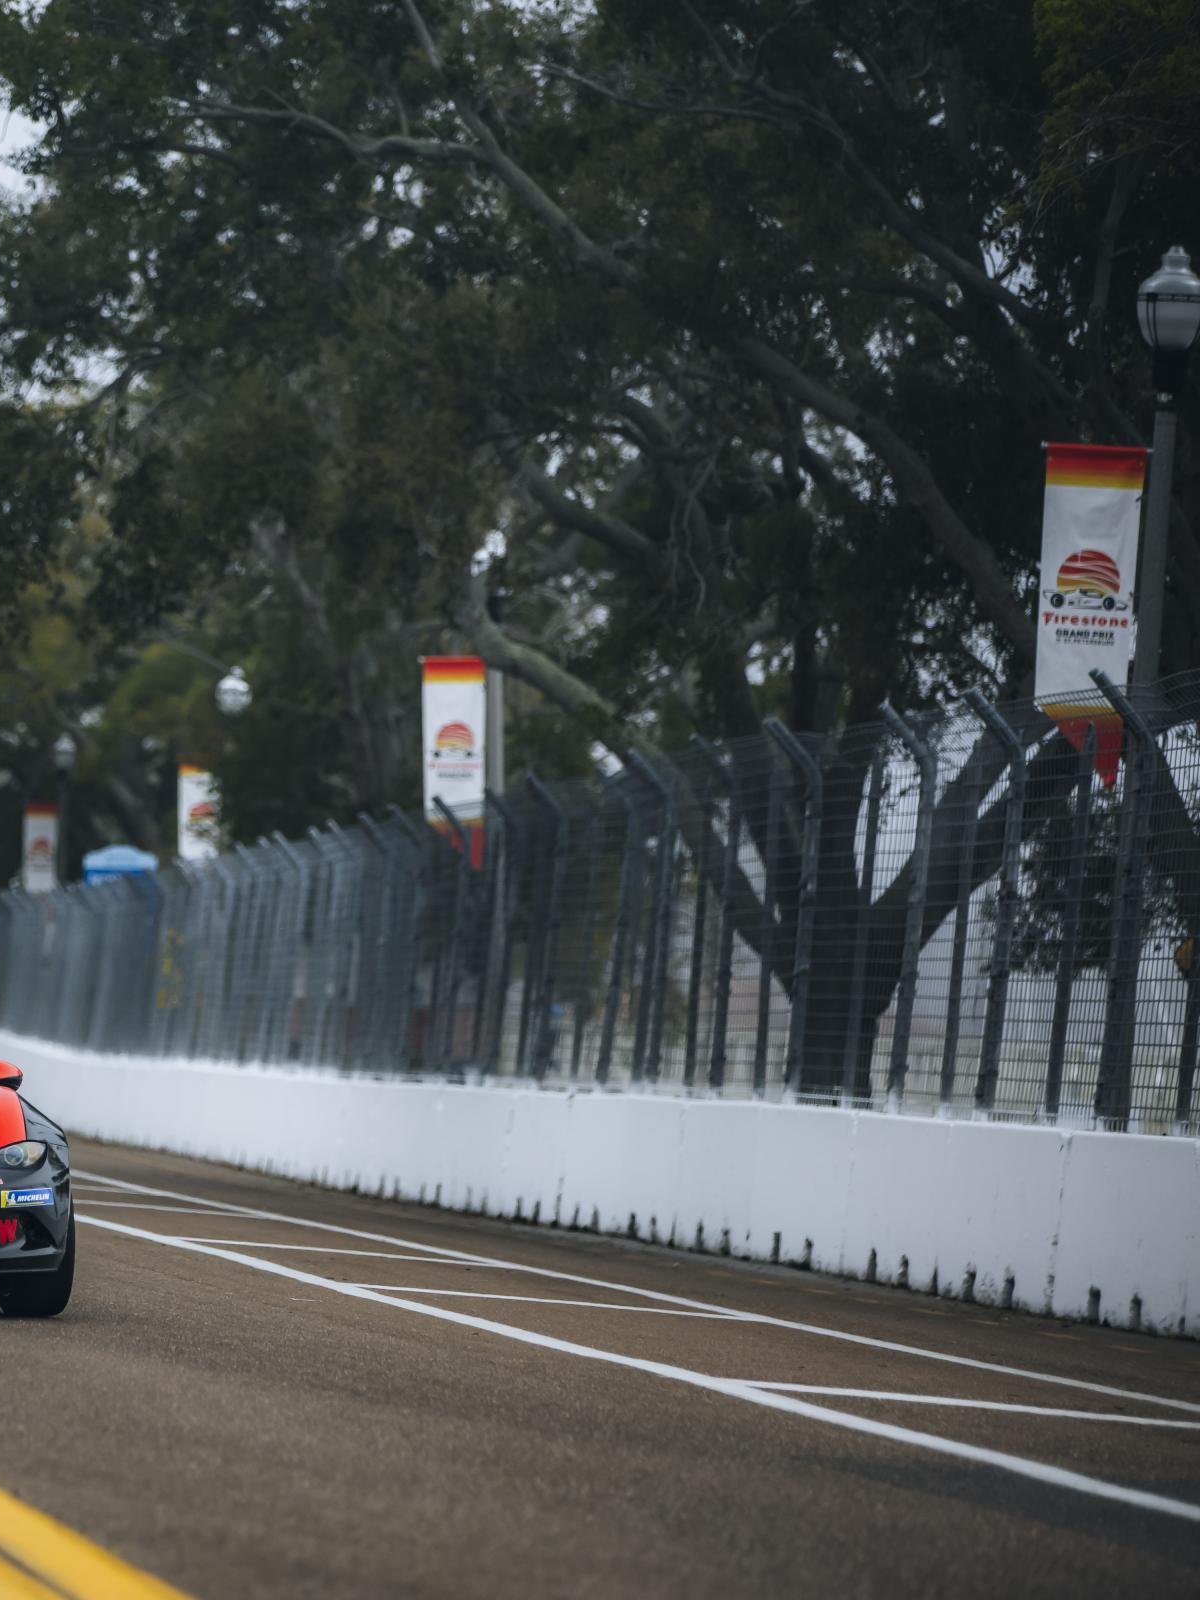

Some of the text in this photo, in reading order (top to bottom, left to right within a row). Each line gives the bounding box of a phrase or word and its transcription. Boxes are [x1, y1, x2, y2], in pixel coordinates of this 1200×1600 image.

[1043, 611, 1128, 628] Firestone
[1056, 629, 1115, 640] GRAND PRIX
[17, 1193, 50, 1202] MICHELIN
